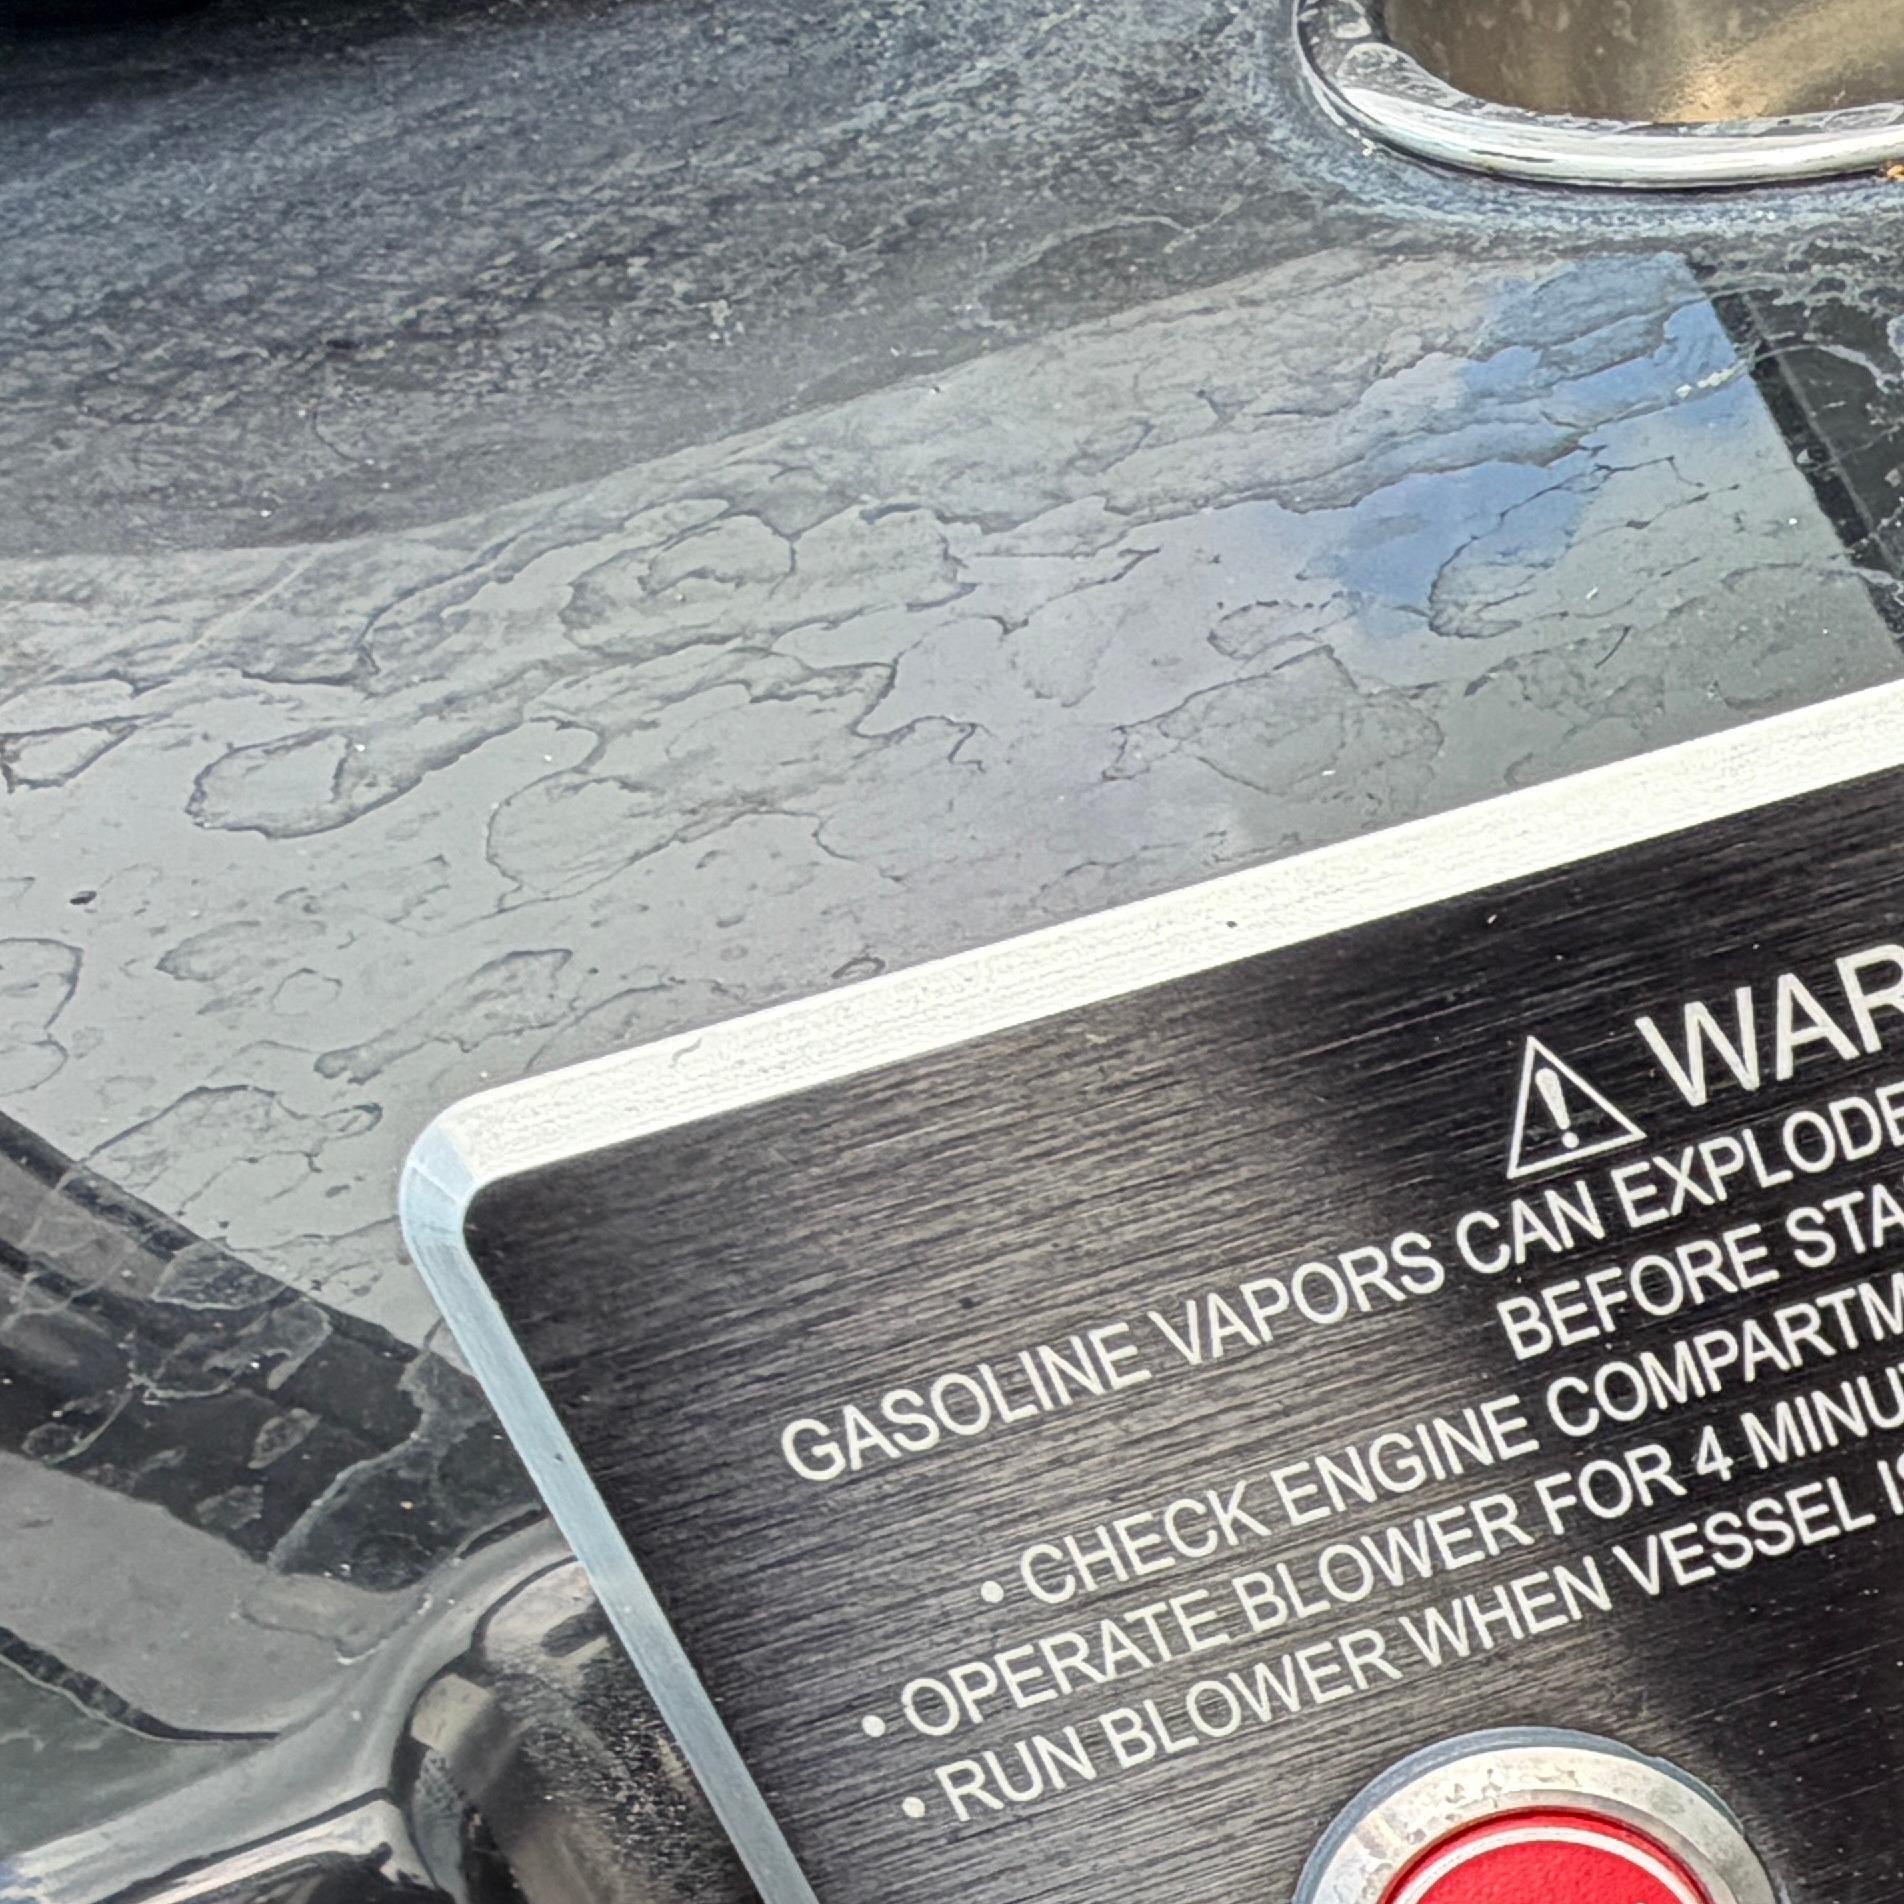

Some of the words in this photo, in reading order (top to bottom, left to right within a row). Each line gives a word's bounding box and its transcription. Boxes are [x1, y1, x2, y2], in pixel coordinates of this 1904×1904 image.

[781, 1323, 1151, 1481] GASOLINE
[1149, 1231, 1445, 1365] VAPORS
[1456, 1180, 1605, 1273] CAN
[1497, 1223, 1779, 1360] BEFORE
[901, 1590, 1230, 1735] OPERATE
[1233, 1494, 1534, 1632] BLOWER
[1535, 1444, 1687, 1535] FOR
[1695, 1425, 1733, 1481] 4
[935, 1727, 1095, 1821] RUN
[1099, 1629, 1401, 1767] BLOWER
[1399, 1556, 1612, 1666] WHEN
[1612, 1477, 1876, 1595] VESSEL
[1021, 1481, 1271, 1603] CHECK
[1271, 1395, 1539, 1525] ENGINE
